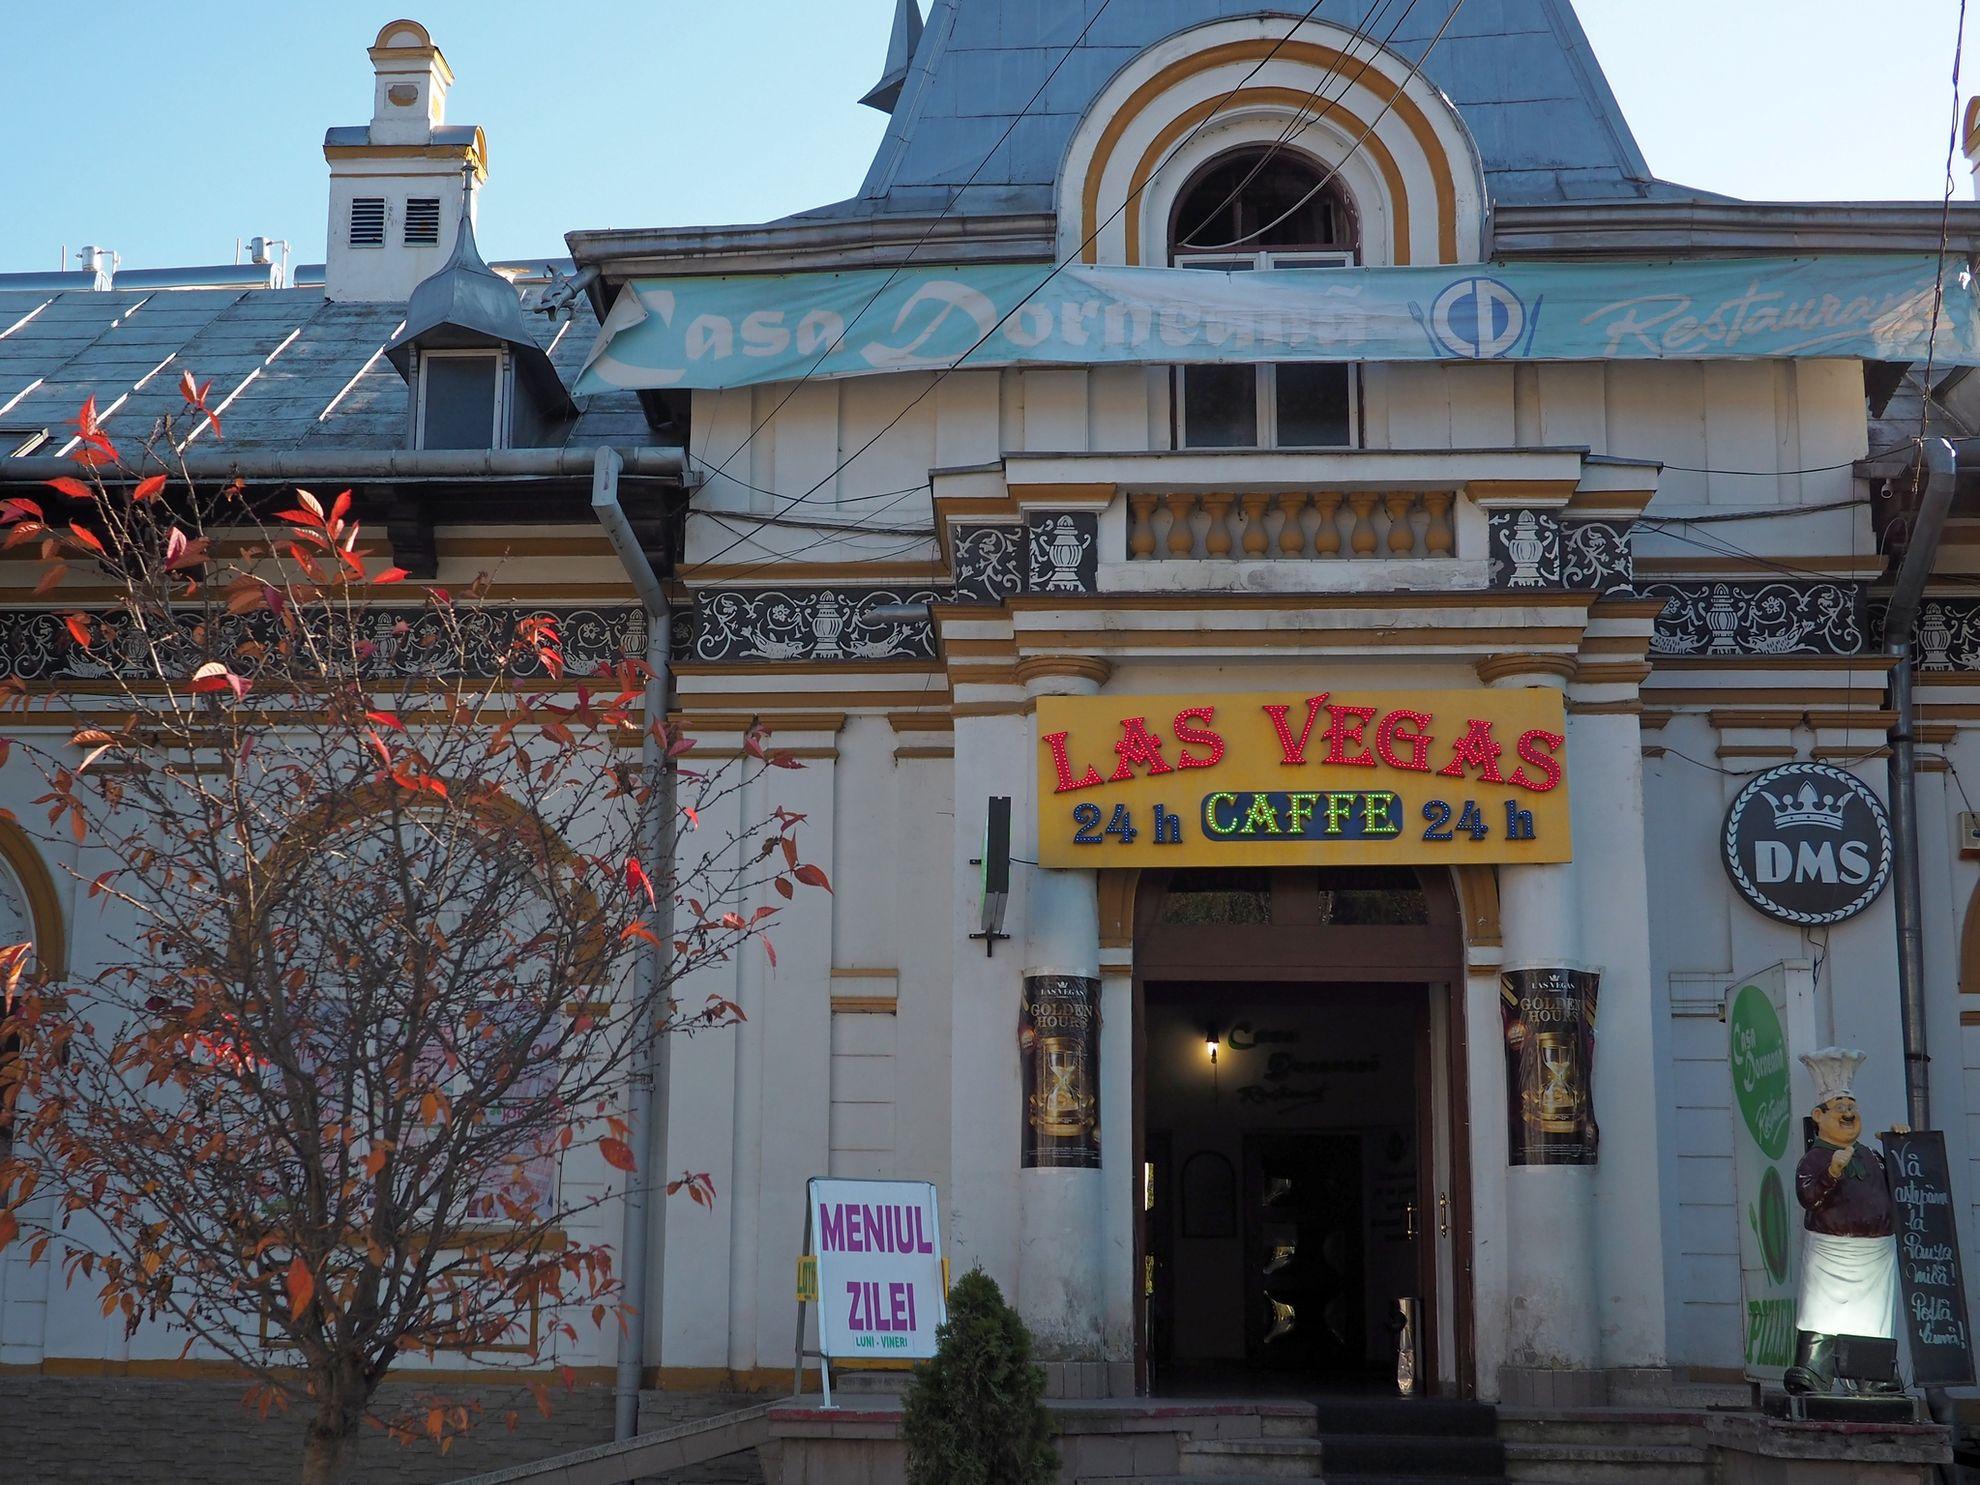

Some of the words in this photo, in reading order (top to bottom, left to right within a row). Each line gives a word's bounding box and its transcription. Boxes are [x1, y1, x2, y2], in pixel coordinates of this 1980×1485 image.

[594, 289, 846, 386] Casa
[1041, 705, 1226, 793] LAS
[1262, 692, 1565, 792] VEGAS
[1072, 802, 1137, 844] 24
[1152, 803, 1183, 844] h
[1205, 792, 1400, 835] CAFFE
[1421, 799, 1489, 841] 24
[1504, 799, 1537, 841] h
[1754, 840, 1871, 885] DMS
[1030, 1003, 1093, 1017] GOLDEN
[820, 1203, 933, 1254] MENIUL
[846, 1281, 917, 1331] ZILEI
[855, 1336, 875, 1348] LUNI
[881, 1337, 908, 1349] VINERI
